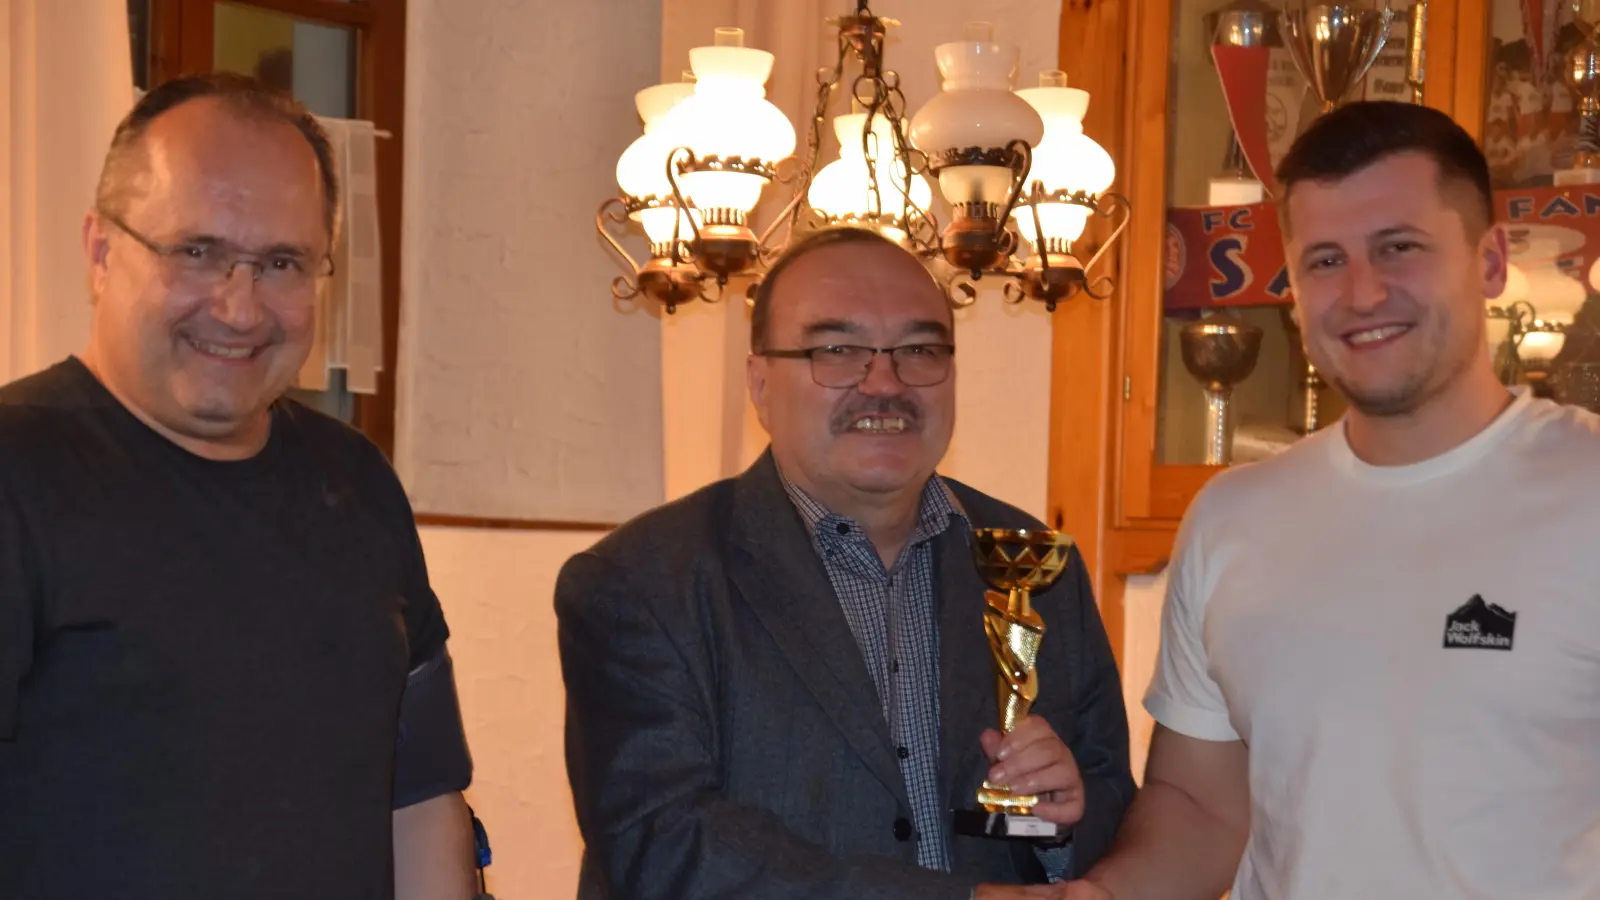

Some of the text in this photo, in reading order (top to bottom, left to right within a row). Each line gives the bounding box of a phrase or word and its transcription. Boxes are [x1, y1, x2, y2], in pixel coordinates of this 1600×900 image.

[1201, 208, 1254, 234] FC
[1448, 620, 1480, 632] Jack
[1446, 632, 1511, 646] Wolfskin
